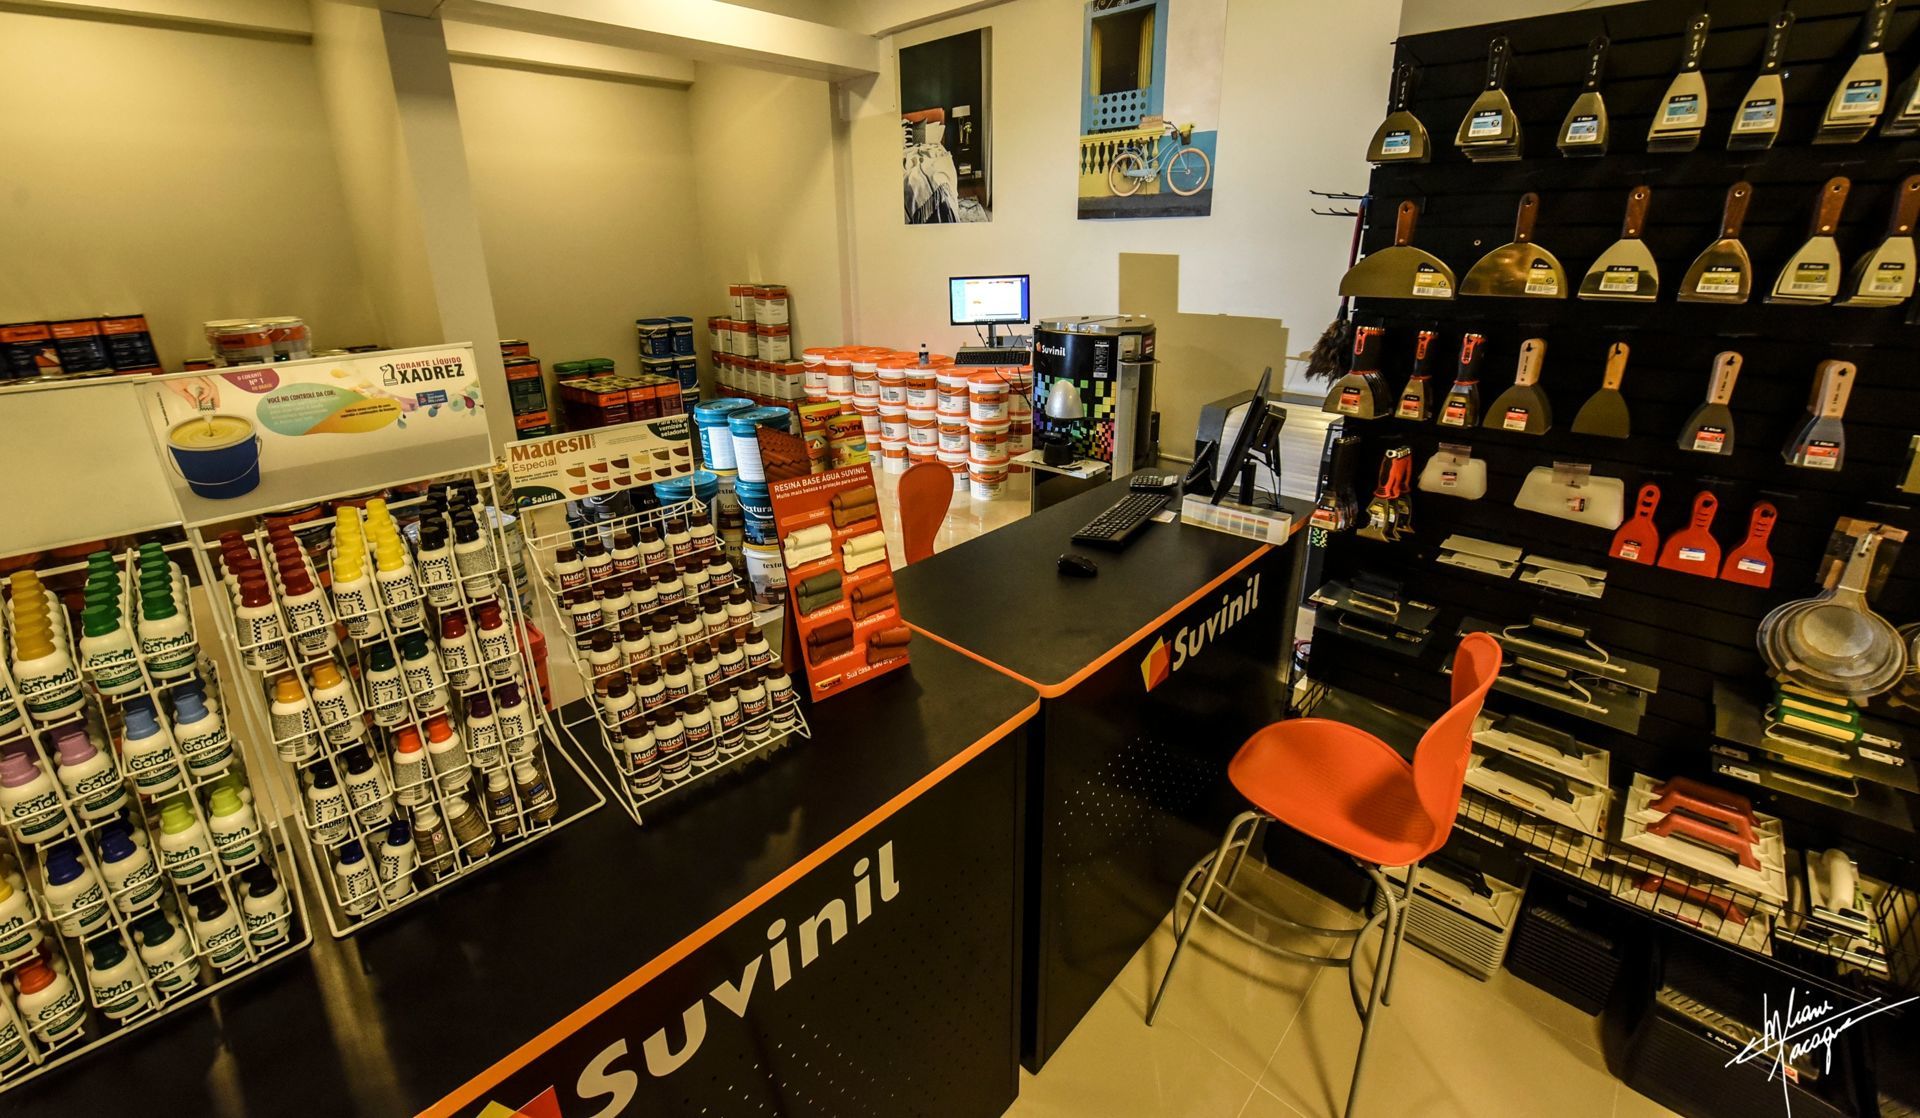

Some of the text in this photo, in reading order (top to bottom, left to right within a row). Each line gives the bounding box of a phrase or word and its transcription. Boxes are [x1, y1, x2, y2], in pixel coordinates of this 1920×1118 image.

[1041, 345, 1066, 357] Suvinil
[396, 356, 462, 370] CORANTE LÍQUIDO
[398, 364, 465, 384] XADREZ
[290, 392, 315, 401] CONTROLE
[805, 411, 840, 424] Suvinil
[829, 424, 862, 435] Suvinil
[511, 434, 591, 462] Madesil
[512, 457, 557, 473] Especial
[774, 467, 866, 493] RESINA BASE ÁGUA SUVINIL
[531, 493, 557, 505] Salisil
[1173, 573, 1260, 672] Suvinil
[846, 667, 858, 679] Sua
[872, 661, 882, 669] seu
[576, 840, 900, 1118] Suvinil
